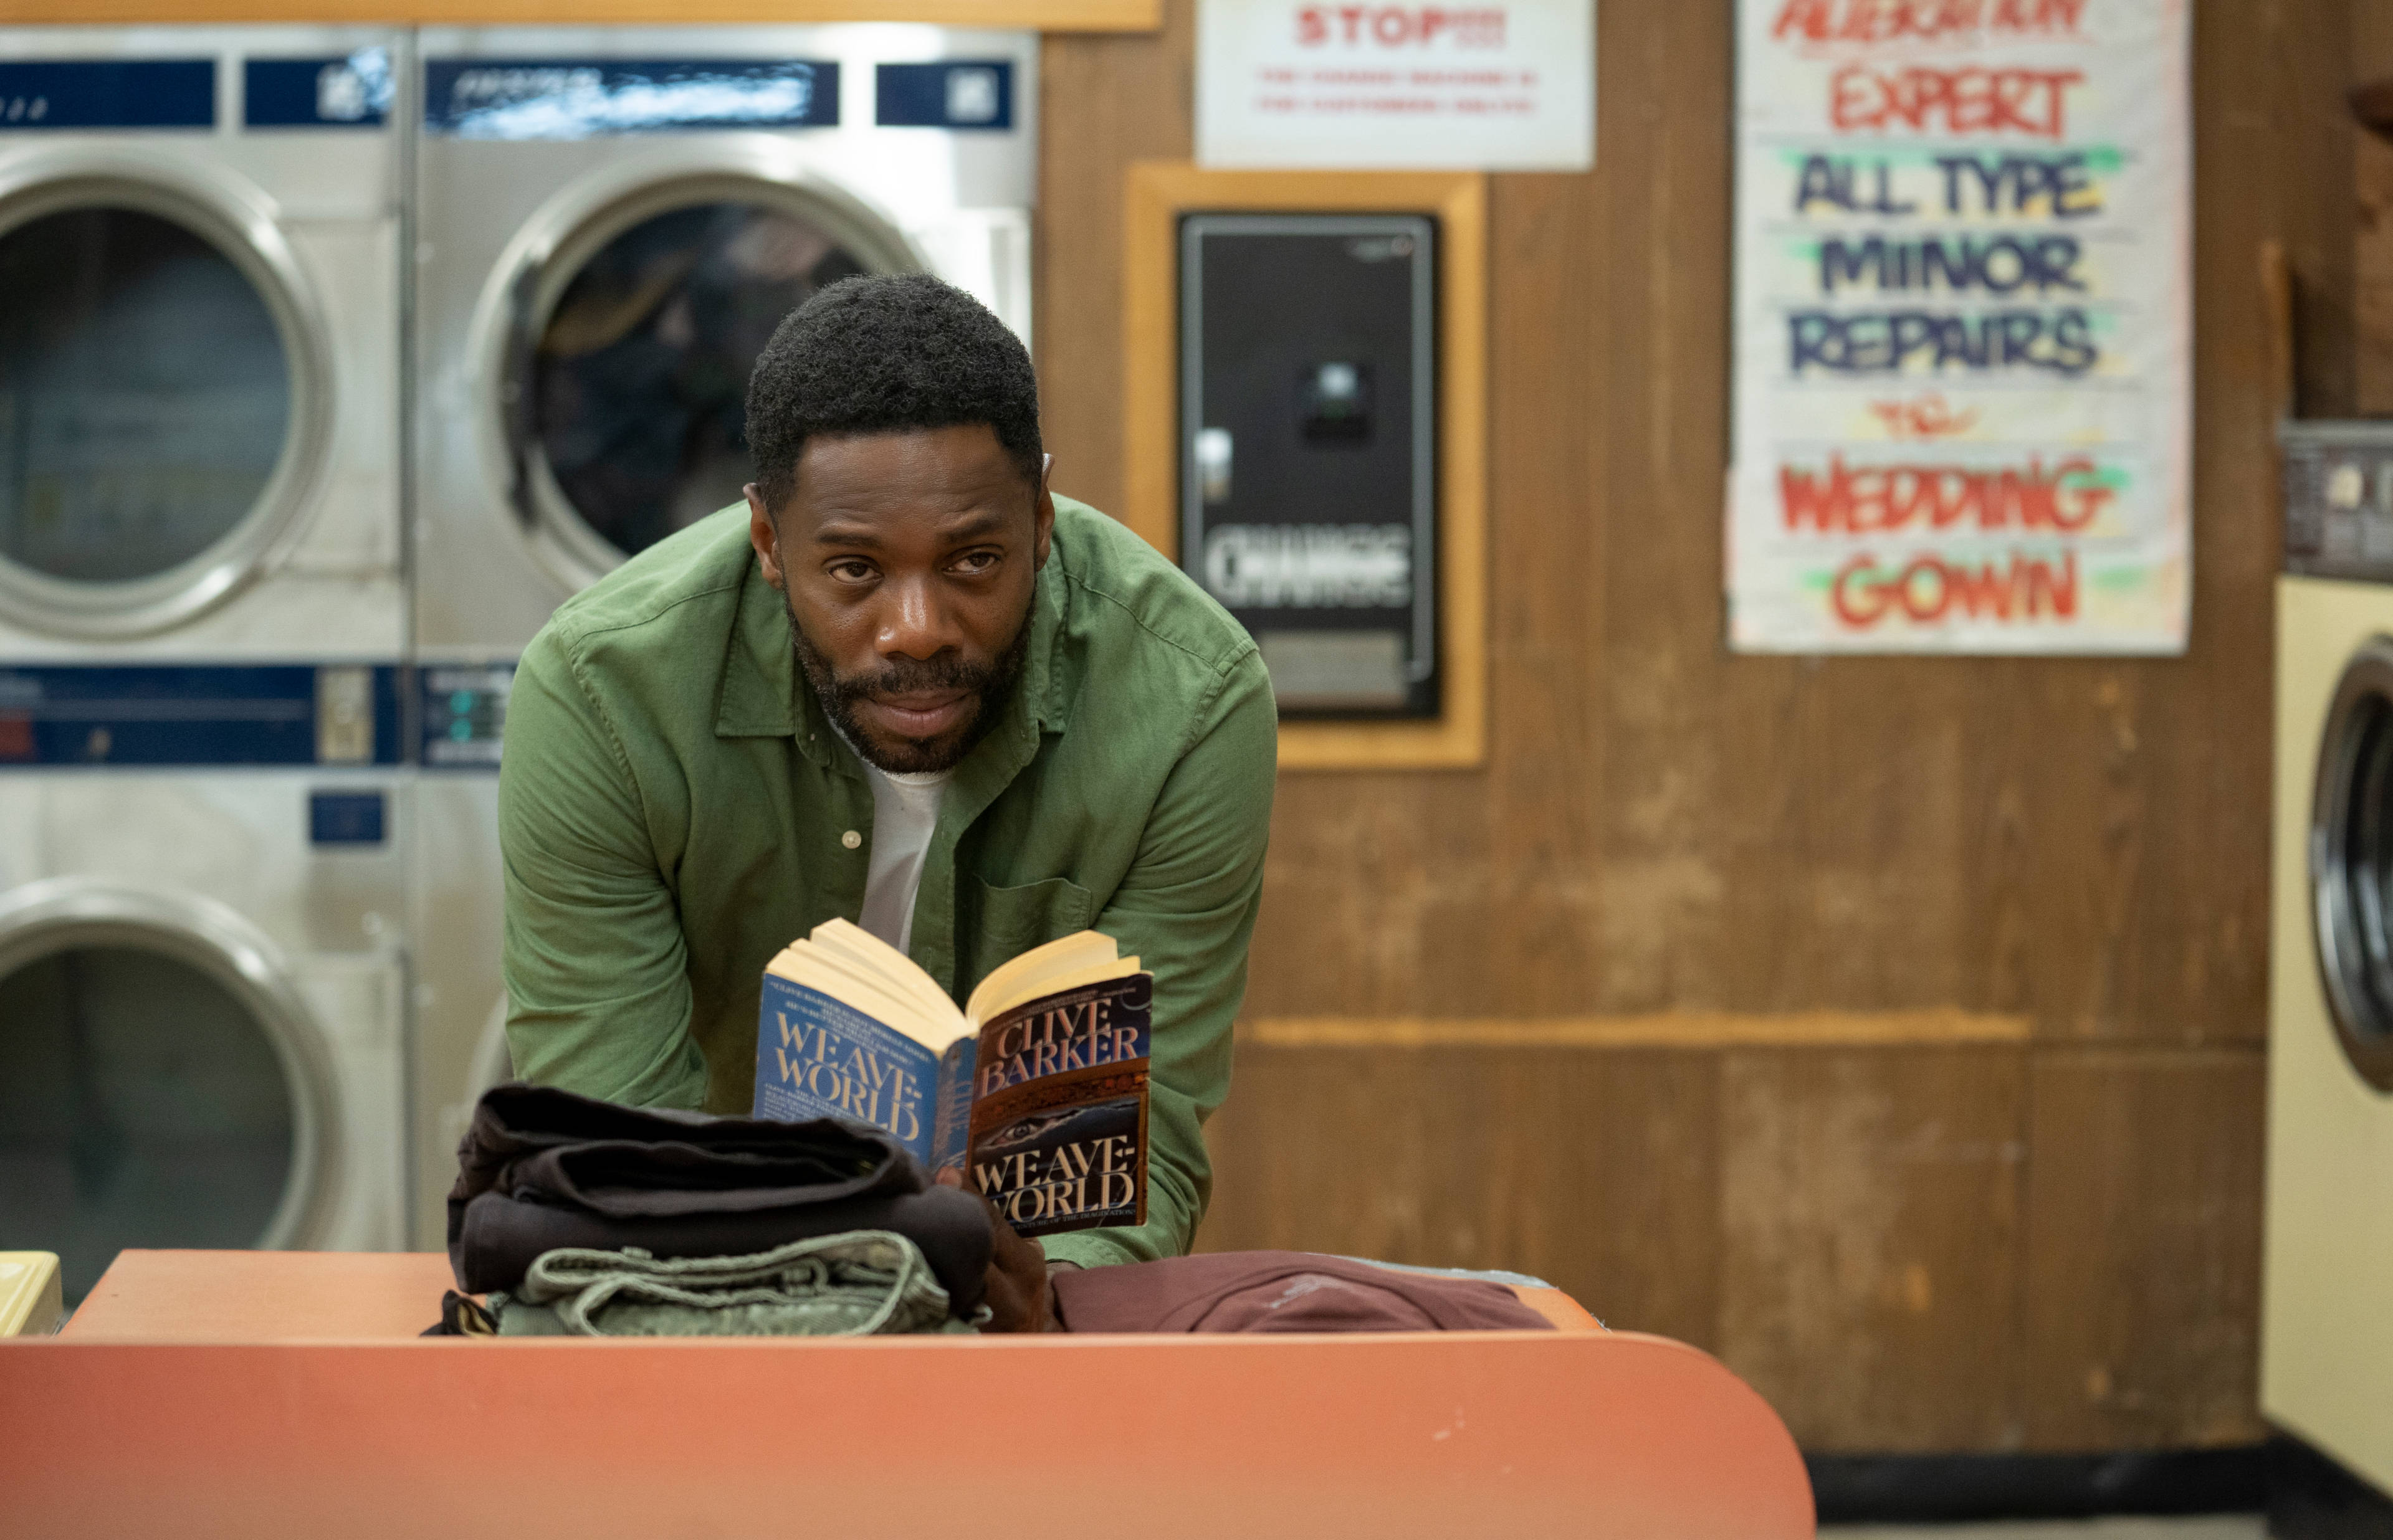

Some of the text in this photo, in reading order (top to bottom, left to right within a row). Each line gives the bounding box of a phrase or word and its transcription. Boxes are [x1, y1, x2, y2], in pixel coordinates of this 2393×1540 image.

[1828, 65, 2086, 141] EXPERT
[1796, 151, 2105, 217] ALL TYPE
[1818, 235, 2086, 293] MINOR
[1789, 310, 2098, 379] REPAIRS
[1778, 450, 2116, 536] WEDDING
[1830, 548, 2079, 629] GOWN
[980, 1026, 1139, 1098] BARKER
[997, 998, 1112, 1059] CLIVE
[776, 1047, 920, 1141] WORLD
